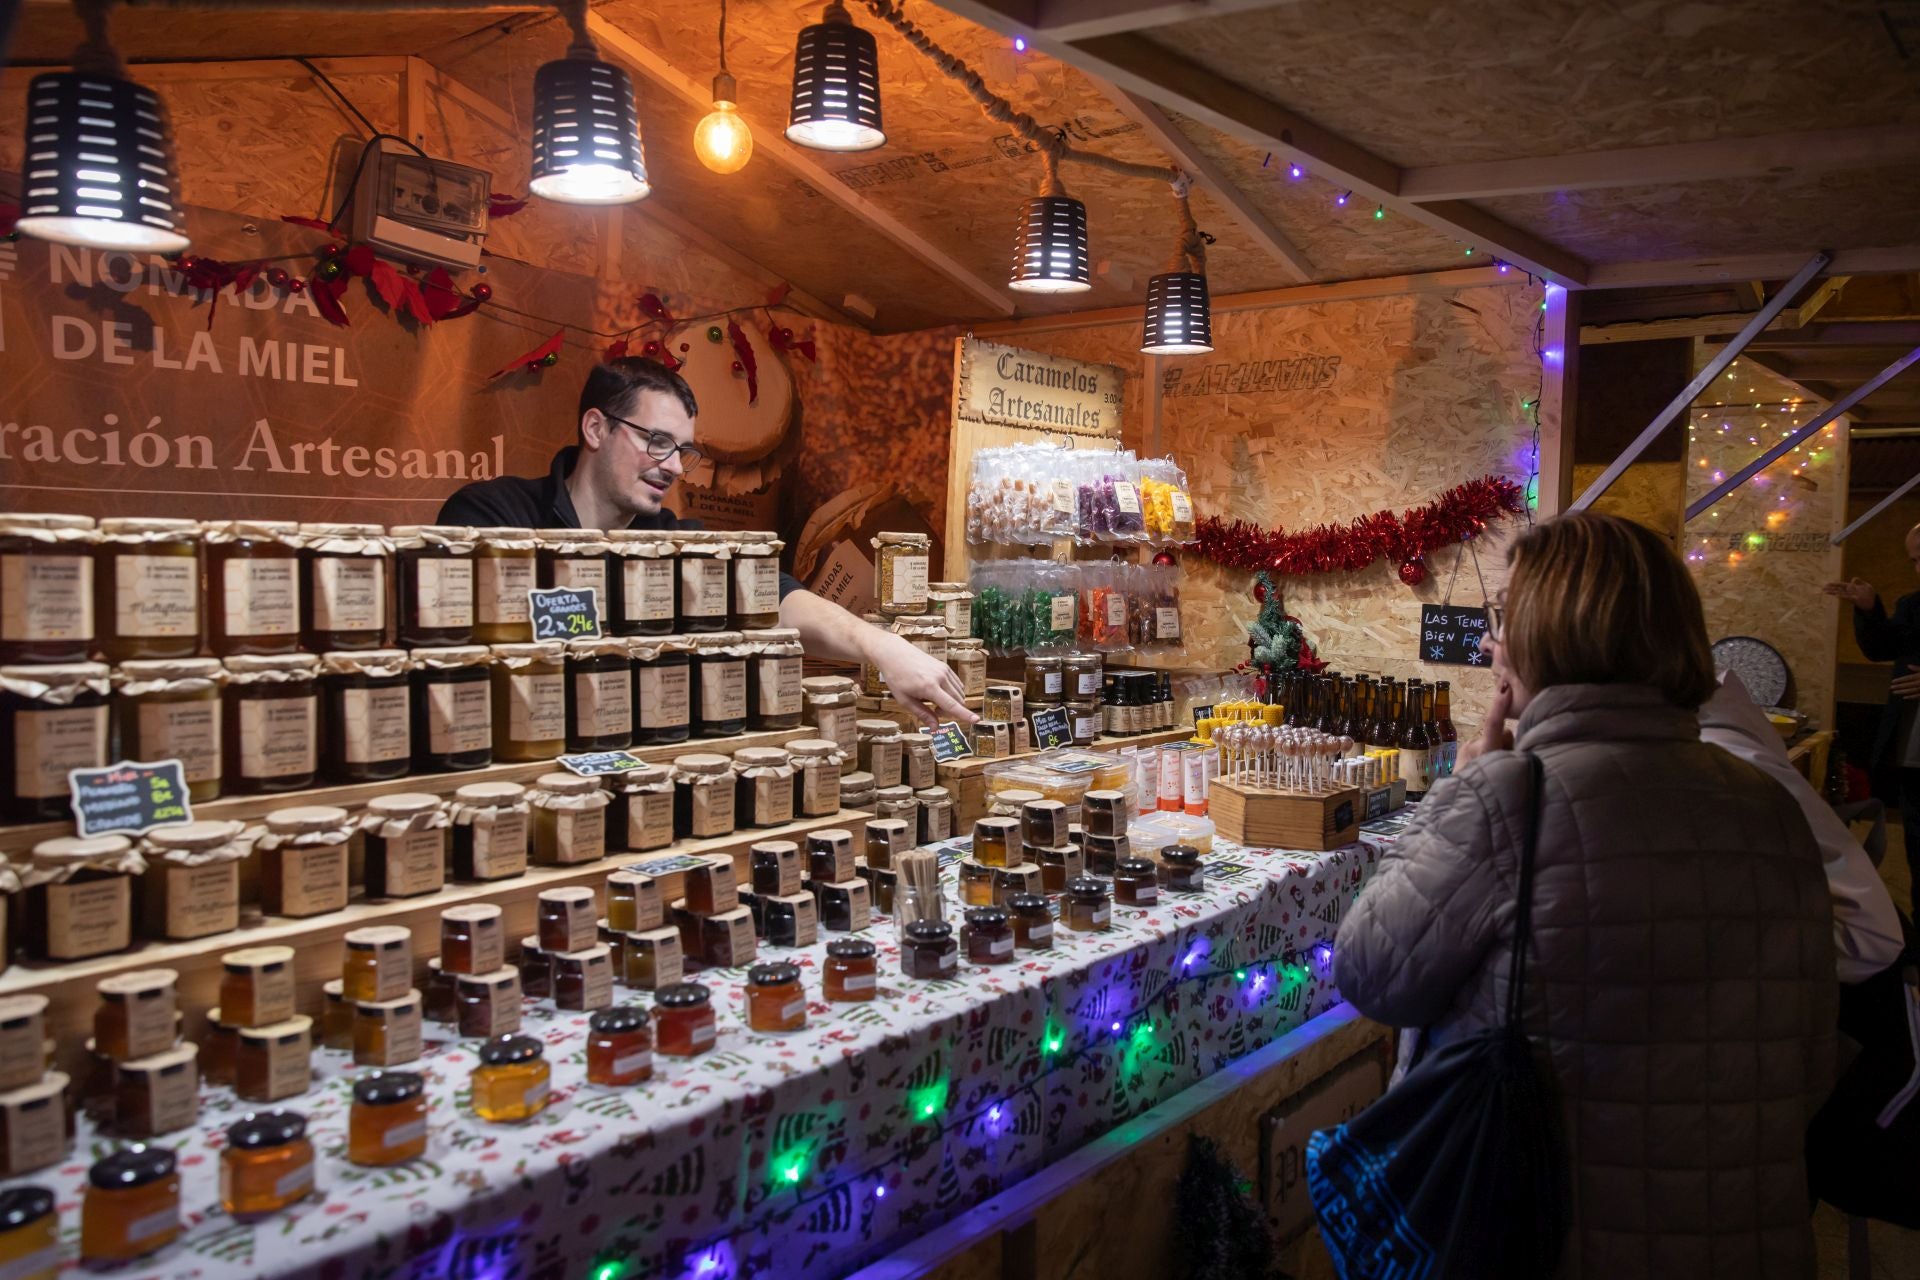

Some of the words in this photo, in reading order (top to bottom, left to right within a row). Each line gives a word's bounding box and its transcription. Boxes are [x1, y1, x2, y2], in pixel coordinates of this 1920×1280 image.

[51, 315, 135, 365] DE
[151, 325, 223, 375] LA
[238, 336, 359, 388] MIEL
[996, 351, 1099, 395] Caramelos
[987, 386, 1101, 430] Artesanales
[233, 417, 504, 482] Artesanal
[838, 572, 854, 594] MIEL
[536, 594, 580, 608] OFERTA
[538, 615, 556, 636] 2
[567, 614, 593, 634] 24€
[1424, 612, 1448, 625] LAS
[1454, 614, 1488, 629] TENE
[1048, 734, 1060, 746] 8€
